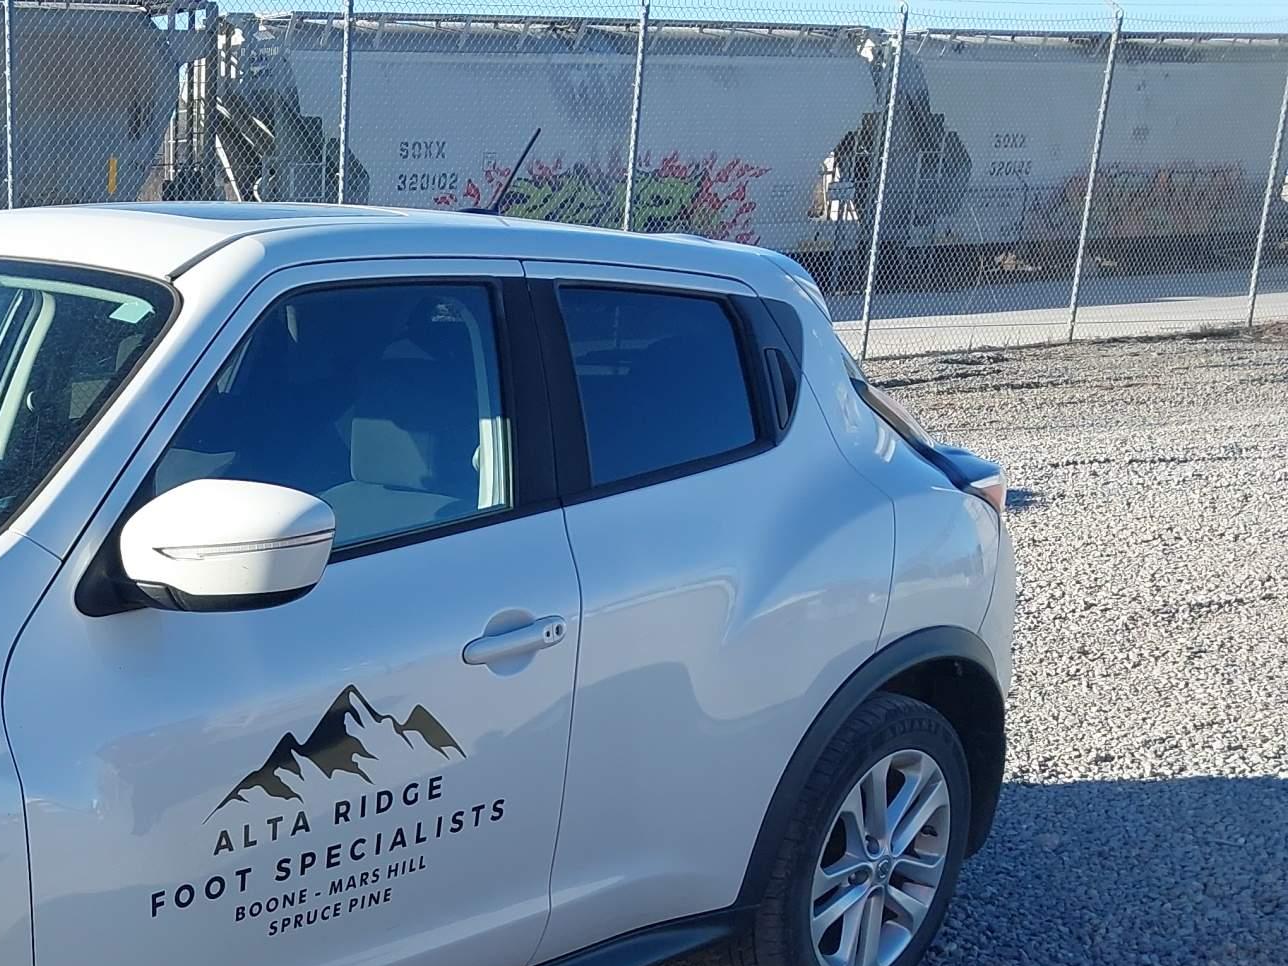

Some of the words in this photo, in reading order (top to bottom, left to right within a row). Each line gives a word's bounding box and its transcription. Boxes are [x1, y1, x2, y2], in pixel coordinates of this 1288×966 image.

[398, 140, 447, 160] SOXX
[397, 172, 459, 192] 320102
[213, 810, 312, 857] ALTA
[334, 775, 444, 825] RIDGE
[150, 867, 253, 918] FOOT
[274, 798, 506, 883] SPECIALISTS
[235, 888, 309, 922] BOONE
[328, 868, 381, 897] MARS
[386, 854, 427, 881] HILL
[268, 902, 343, 937] SPRUCE
[348, 887, 393, 913] PINE
